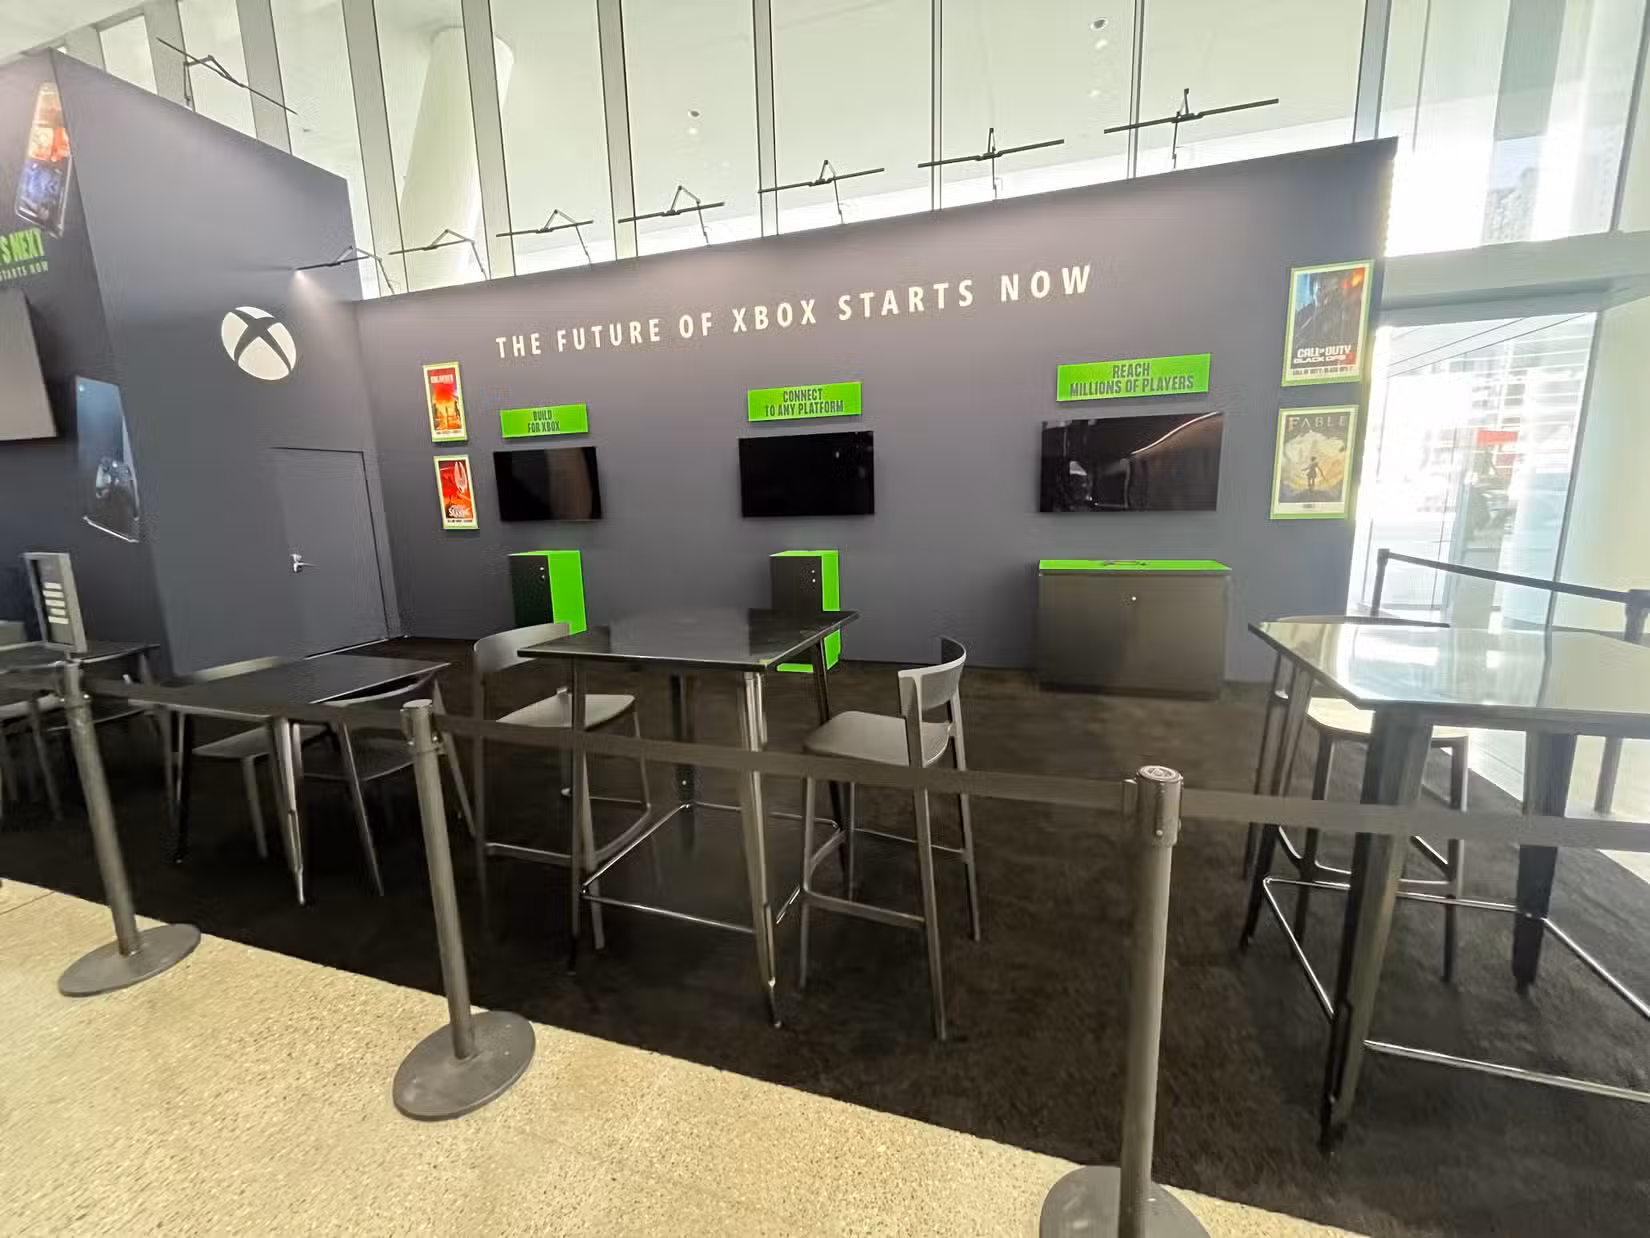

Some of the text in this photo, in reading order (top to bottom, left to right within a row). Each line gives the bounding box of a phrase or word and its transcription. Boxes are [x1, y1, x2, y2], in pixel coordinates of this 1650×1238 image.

[496, 265, 1091, 358] THE FUTURE OF XBOX STARTS NOW
[1297, 347, 1320, 358] CALL
[1325, 344, 1352, 356] DUTY
[1112, 362, 1151, 378] REACH
[1070, 375, 1194, 397] MILLIONS OF PLAYERS
[783, 388, 823, 402] CONNECT
[533, 410, 552, 421] BUILD
[765, 400, 844, 417] TO ANY PLATFORM
[527, 421, 561, 433] FOR XBOX
[1287, 415, 1347, 431] FABLE
